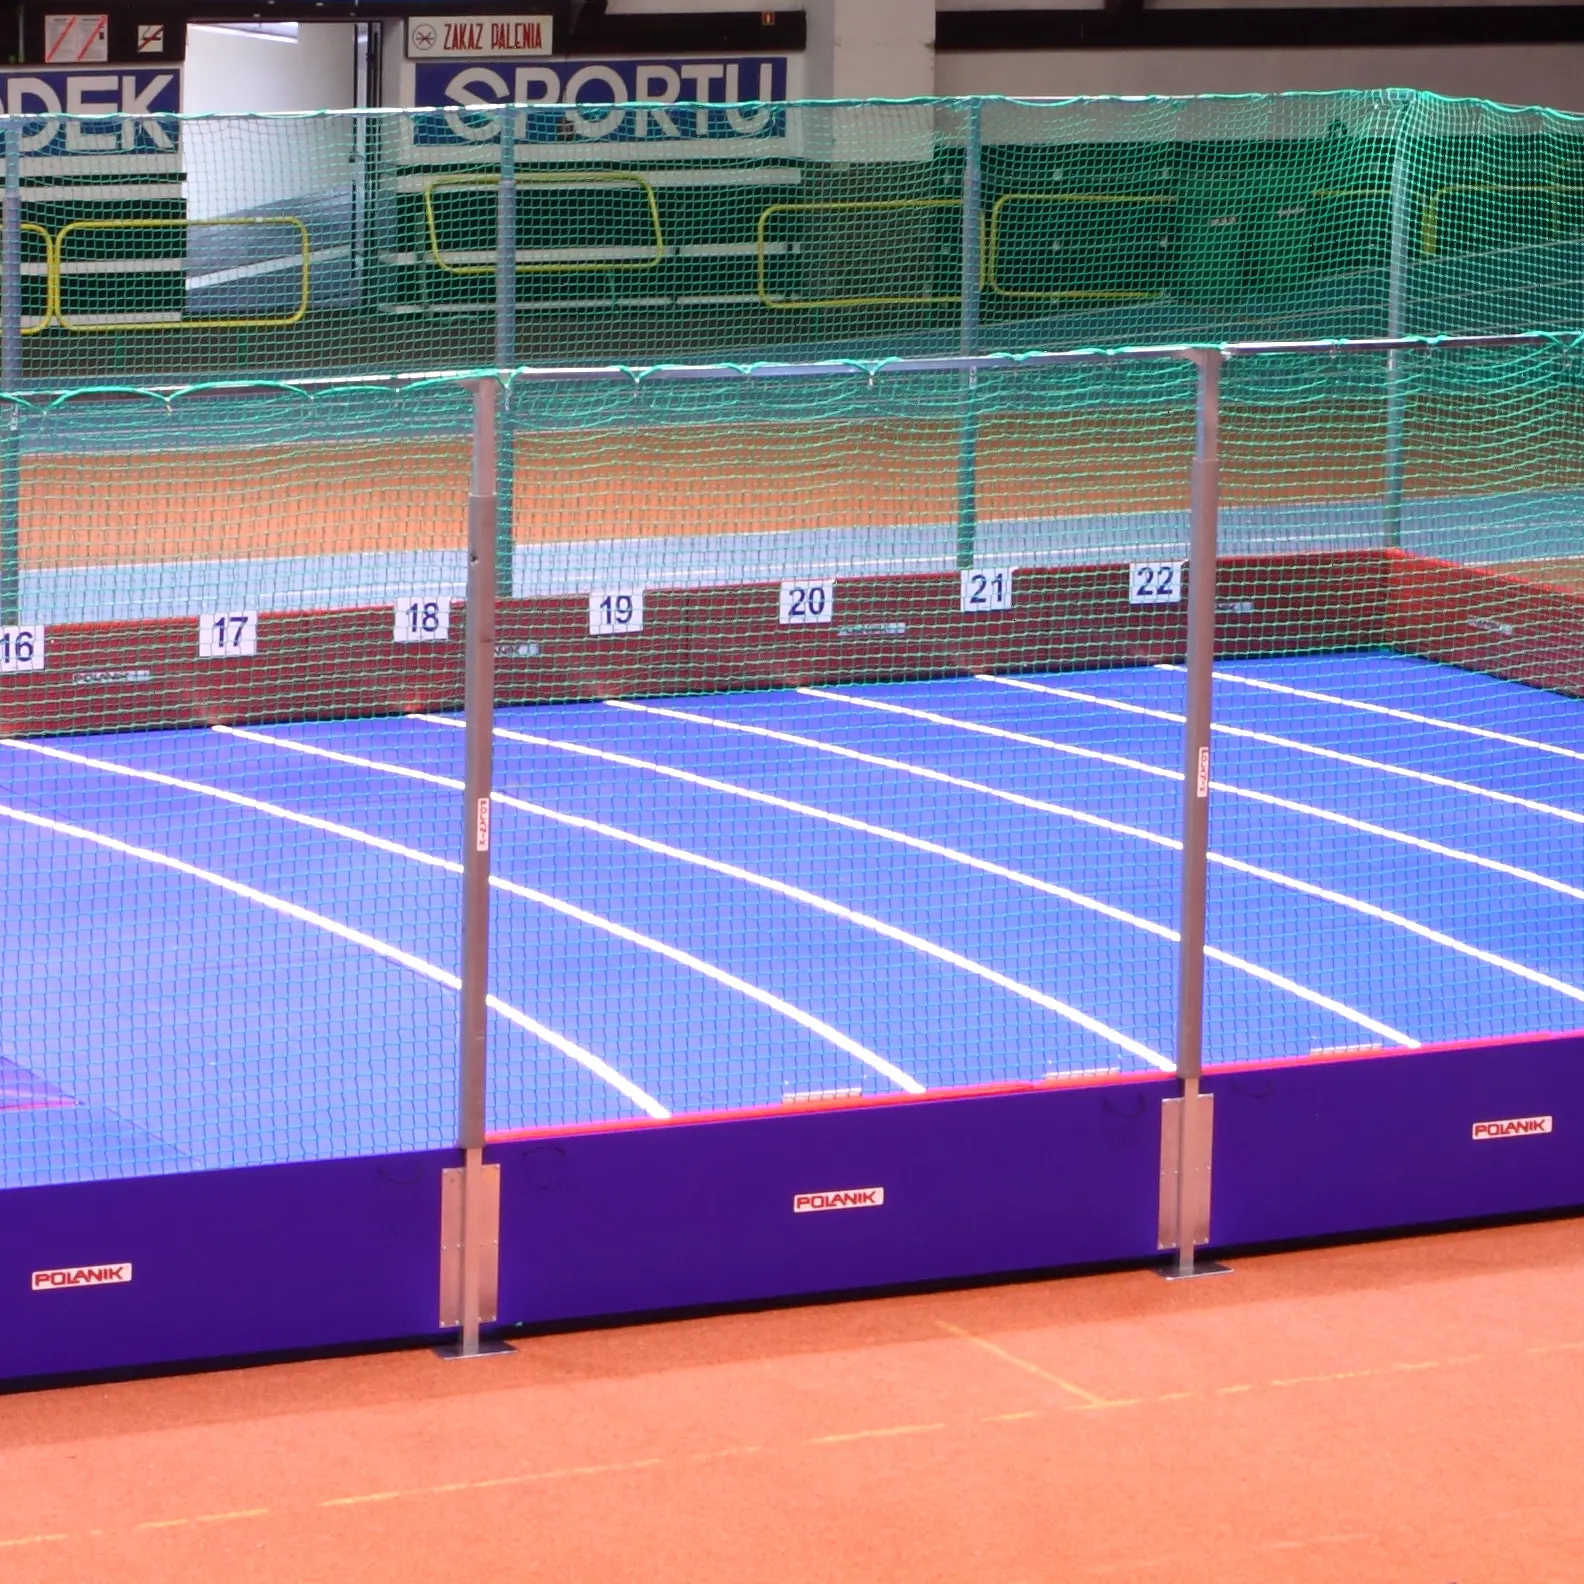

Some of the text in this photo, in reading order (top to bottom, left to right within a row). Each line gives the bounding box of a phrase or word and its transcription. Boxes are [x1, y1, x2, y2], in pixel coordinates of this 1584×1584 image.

[443, 23, 543, 50] ZAKAZ PALENIA
[444, 62, 774, 140] SPORTU
[970, 574, 1004, 606] 21
[1136, 565, 1173, 596] 22
[600, 595, 633, 625] 19
[788, 587, 826, 616] 20
[215, 615, 248, 648] 17
[410, 602, 439, 633] 18
[0, 630, 34, 663] 16
[1474, 1119, 1545, 1137] POLANIK
[796, 1191, 875, 1209] POLANIK
[34, 1266, 123, 1287] POLANIK
